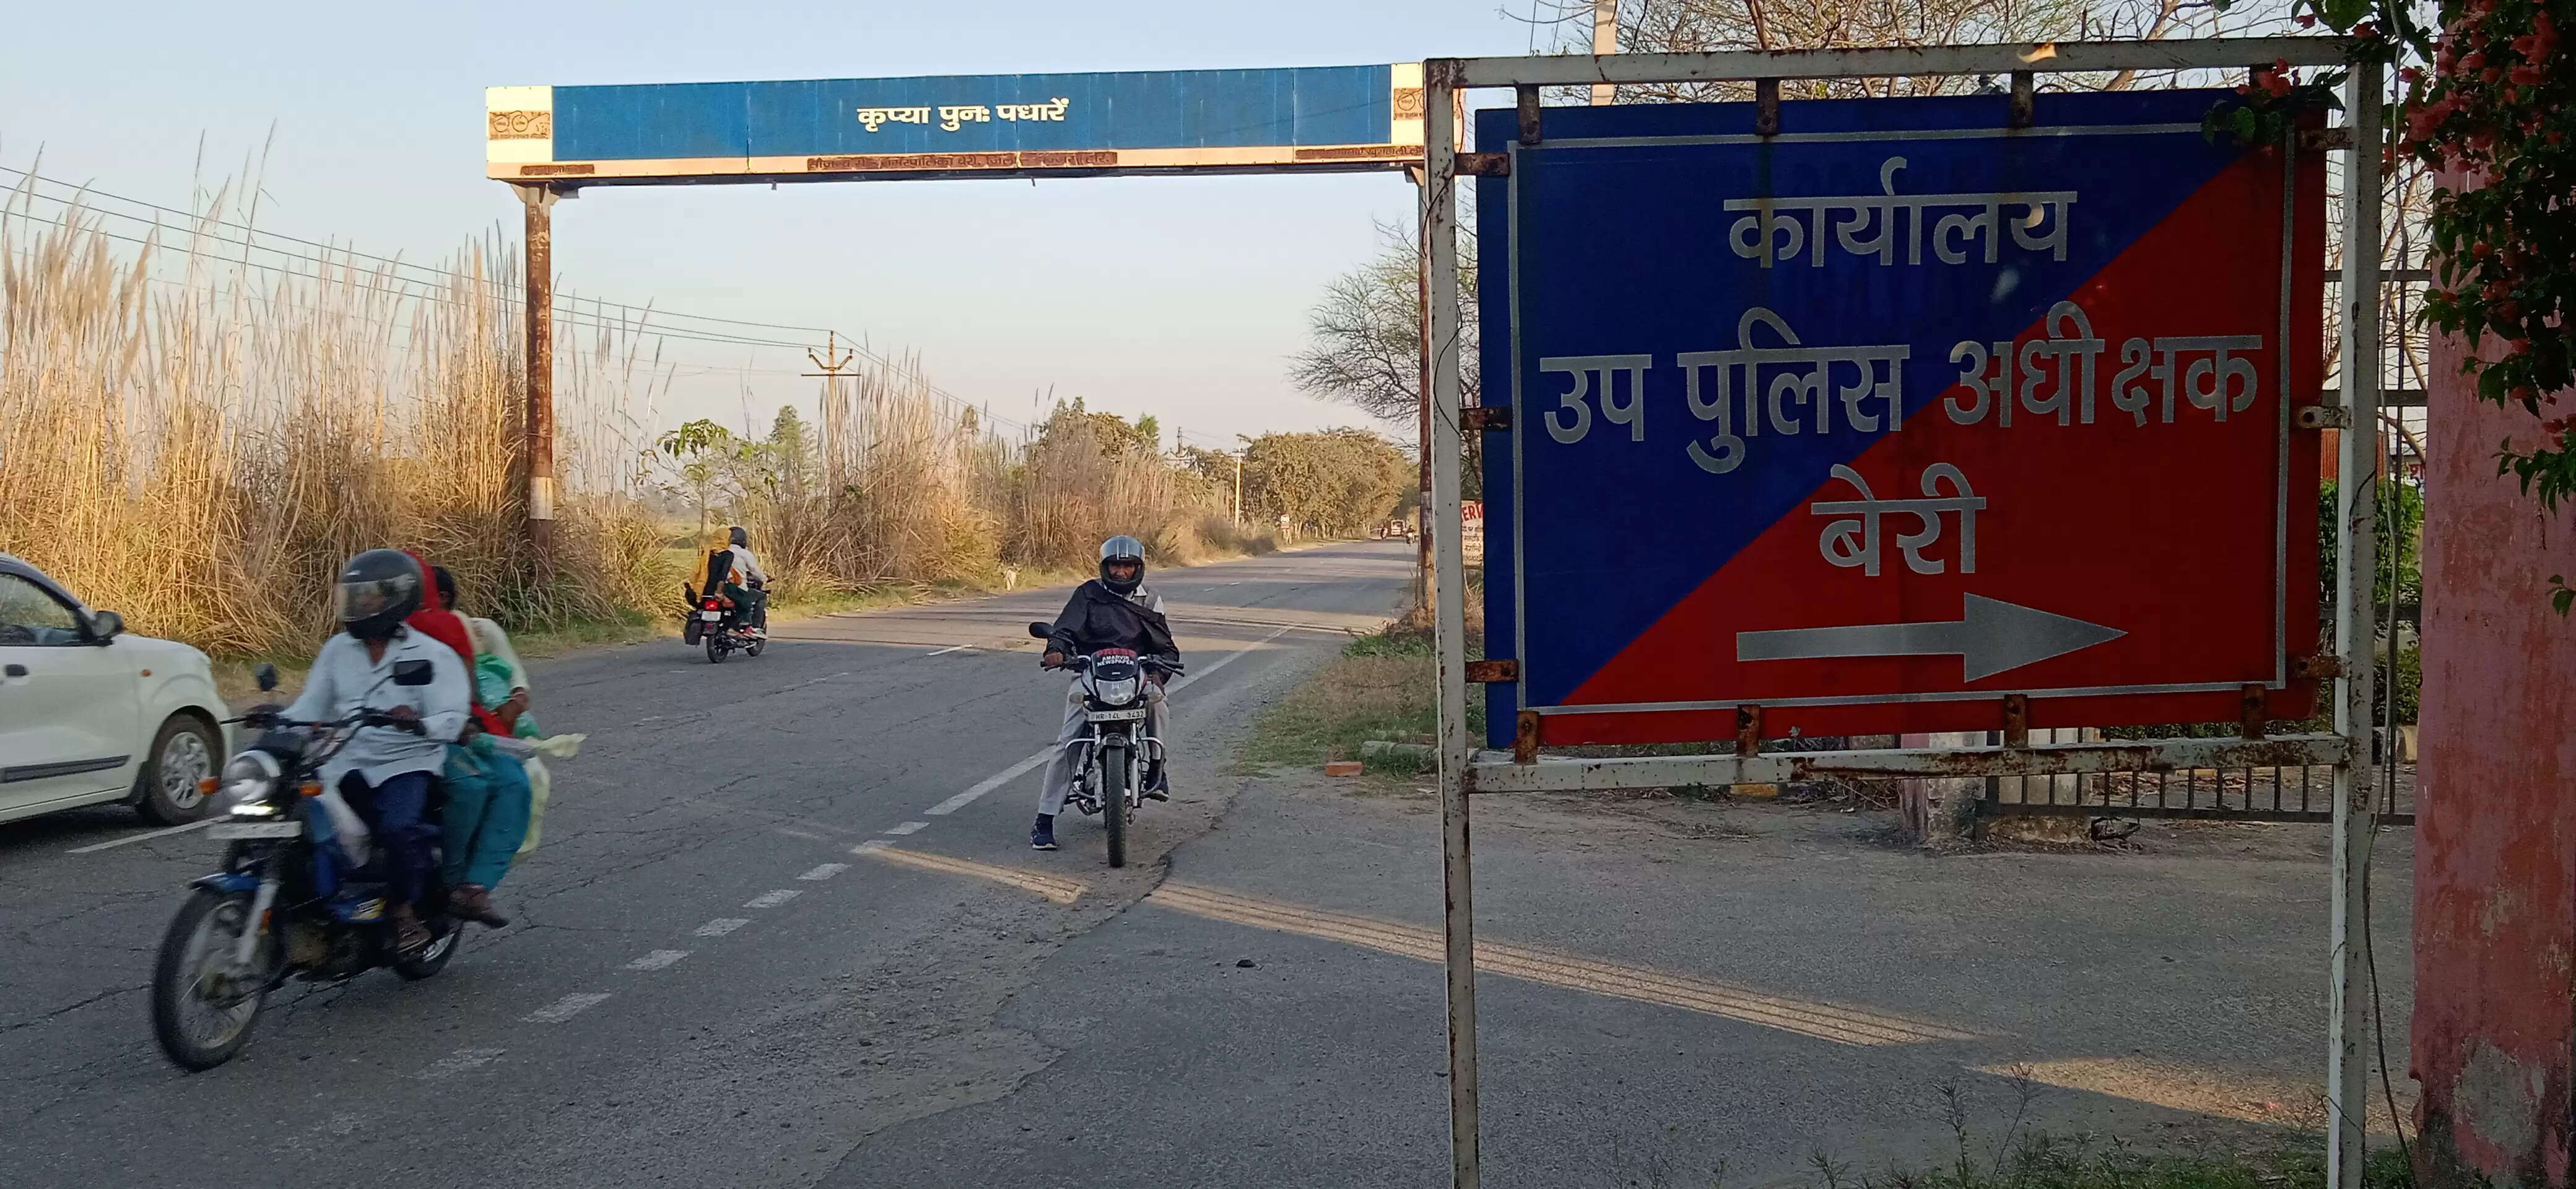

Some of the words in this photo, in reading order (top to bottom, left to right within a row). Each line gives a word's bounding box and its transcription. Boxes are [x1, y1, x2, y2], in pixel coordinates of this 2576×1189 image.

[857, 107, 931, 132] कृप्या
[938, 105, 991, 132] पुनः
[996, 97, 1070, 122] पधारें
[1724, 156, 2078, 269] कार्यालय
[1540, 354, 1652, 443] उप
[1677, 307, 1910, 474] पुलिस
[1944, 301, 2263, 429] अधीक्षक
[1461, 504, 1484, 523] ERV
[1811, 463, 1986, 577] बेरी
